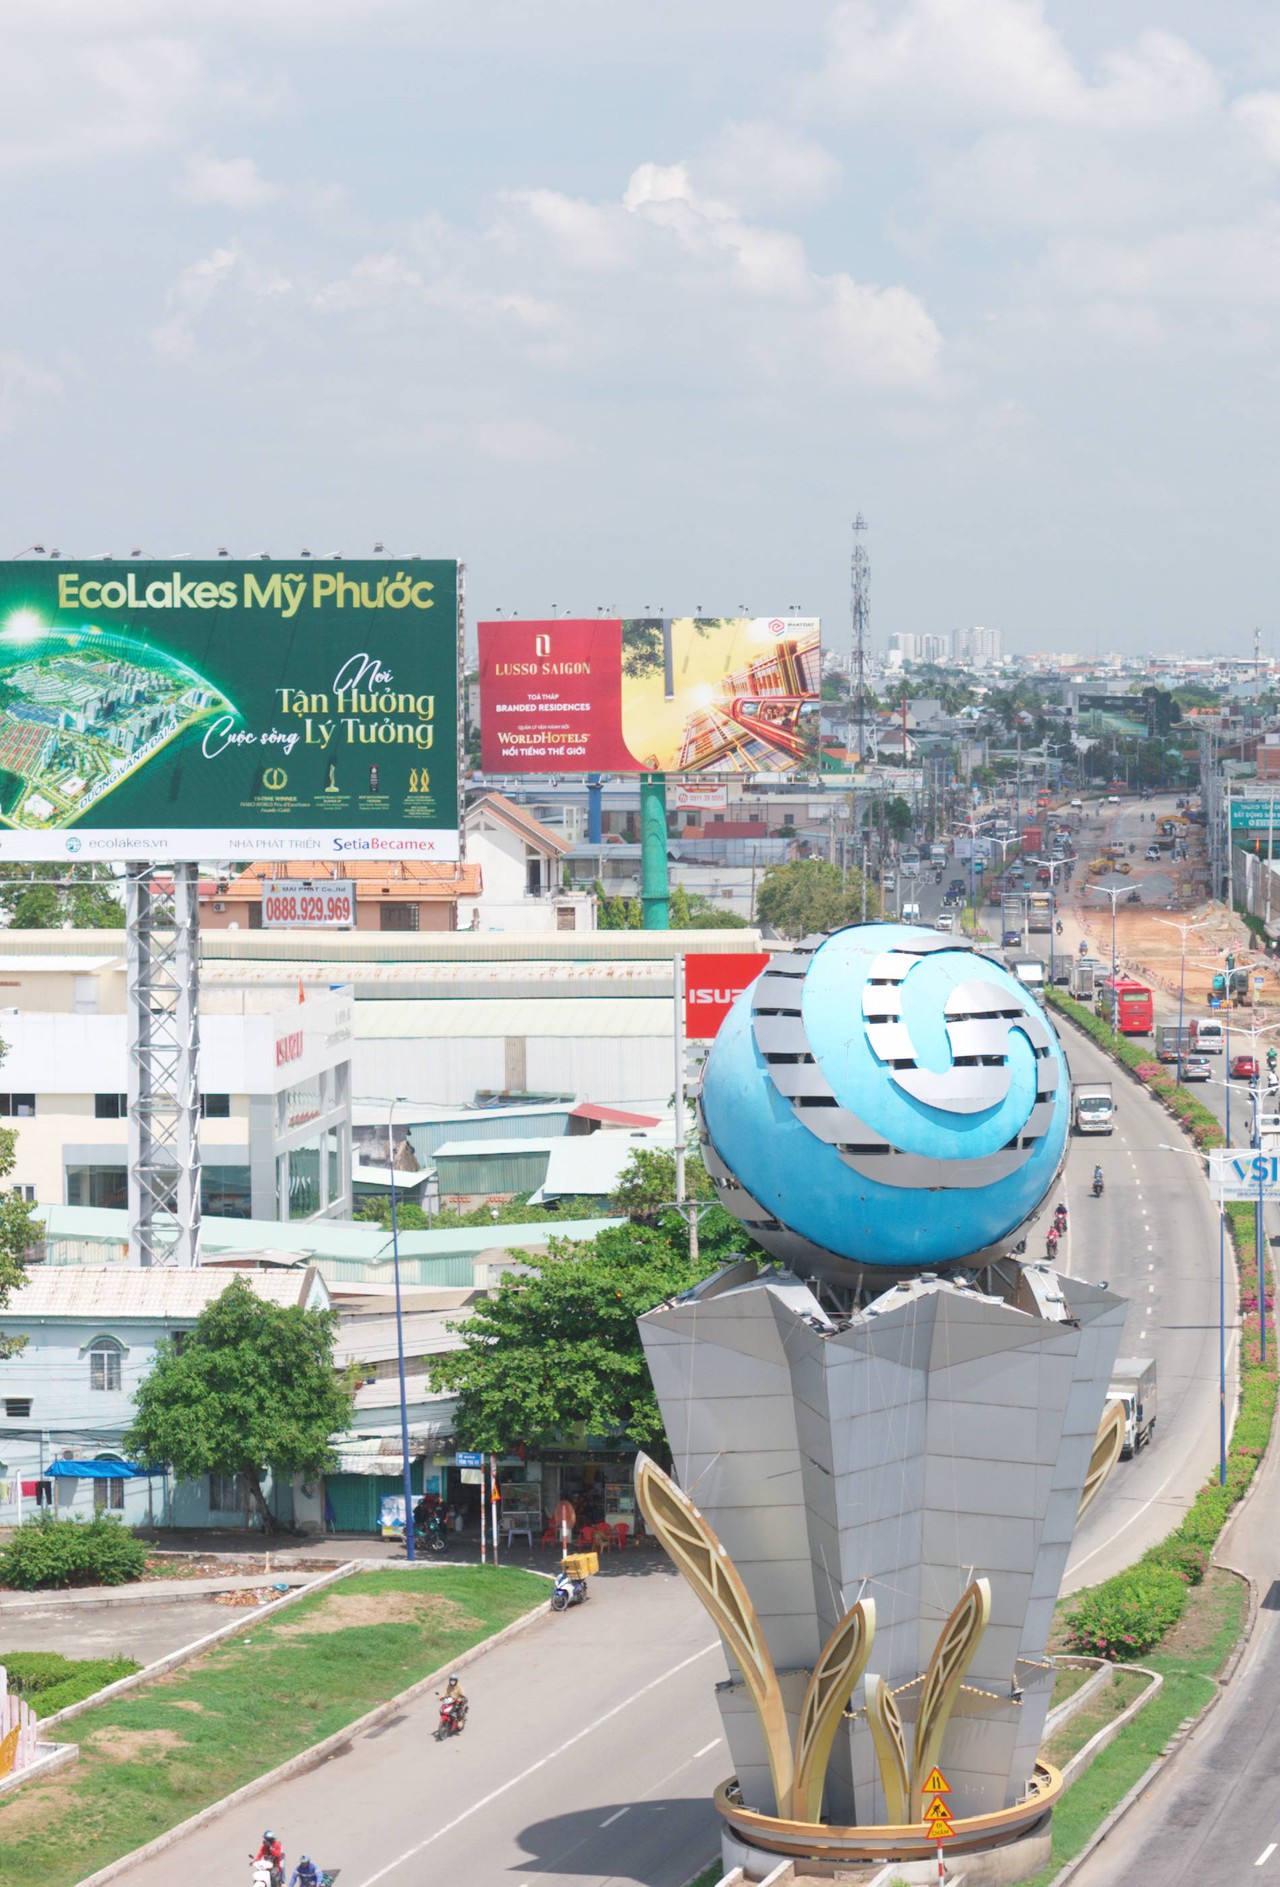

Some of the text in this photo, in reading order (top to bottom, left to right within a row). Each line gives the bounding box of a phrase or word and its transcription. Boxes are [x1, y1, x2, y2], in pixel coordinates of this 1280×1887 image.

[58, 571, 435, 618] EcoLakes Mỹ Phước
[333, 652, 394, 694] Nơi
[495, 662, 591, 676] LUSSO SAIGON
[275, 687, 435, 721] Tận Hưởng
[496, 703, 591, 713] BRANDED RESIDENCES
[202, 715, 434, 759] Cuộc sống Lý Tưởng
[88, 837, 168, 849] ecolakes.vn
[332, 837, 435, 851] SetiaBecamex
[265, 896, 351, 921] 0888.929.969
